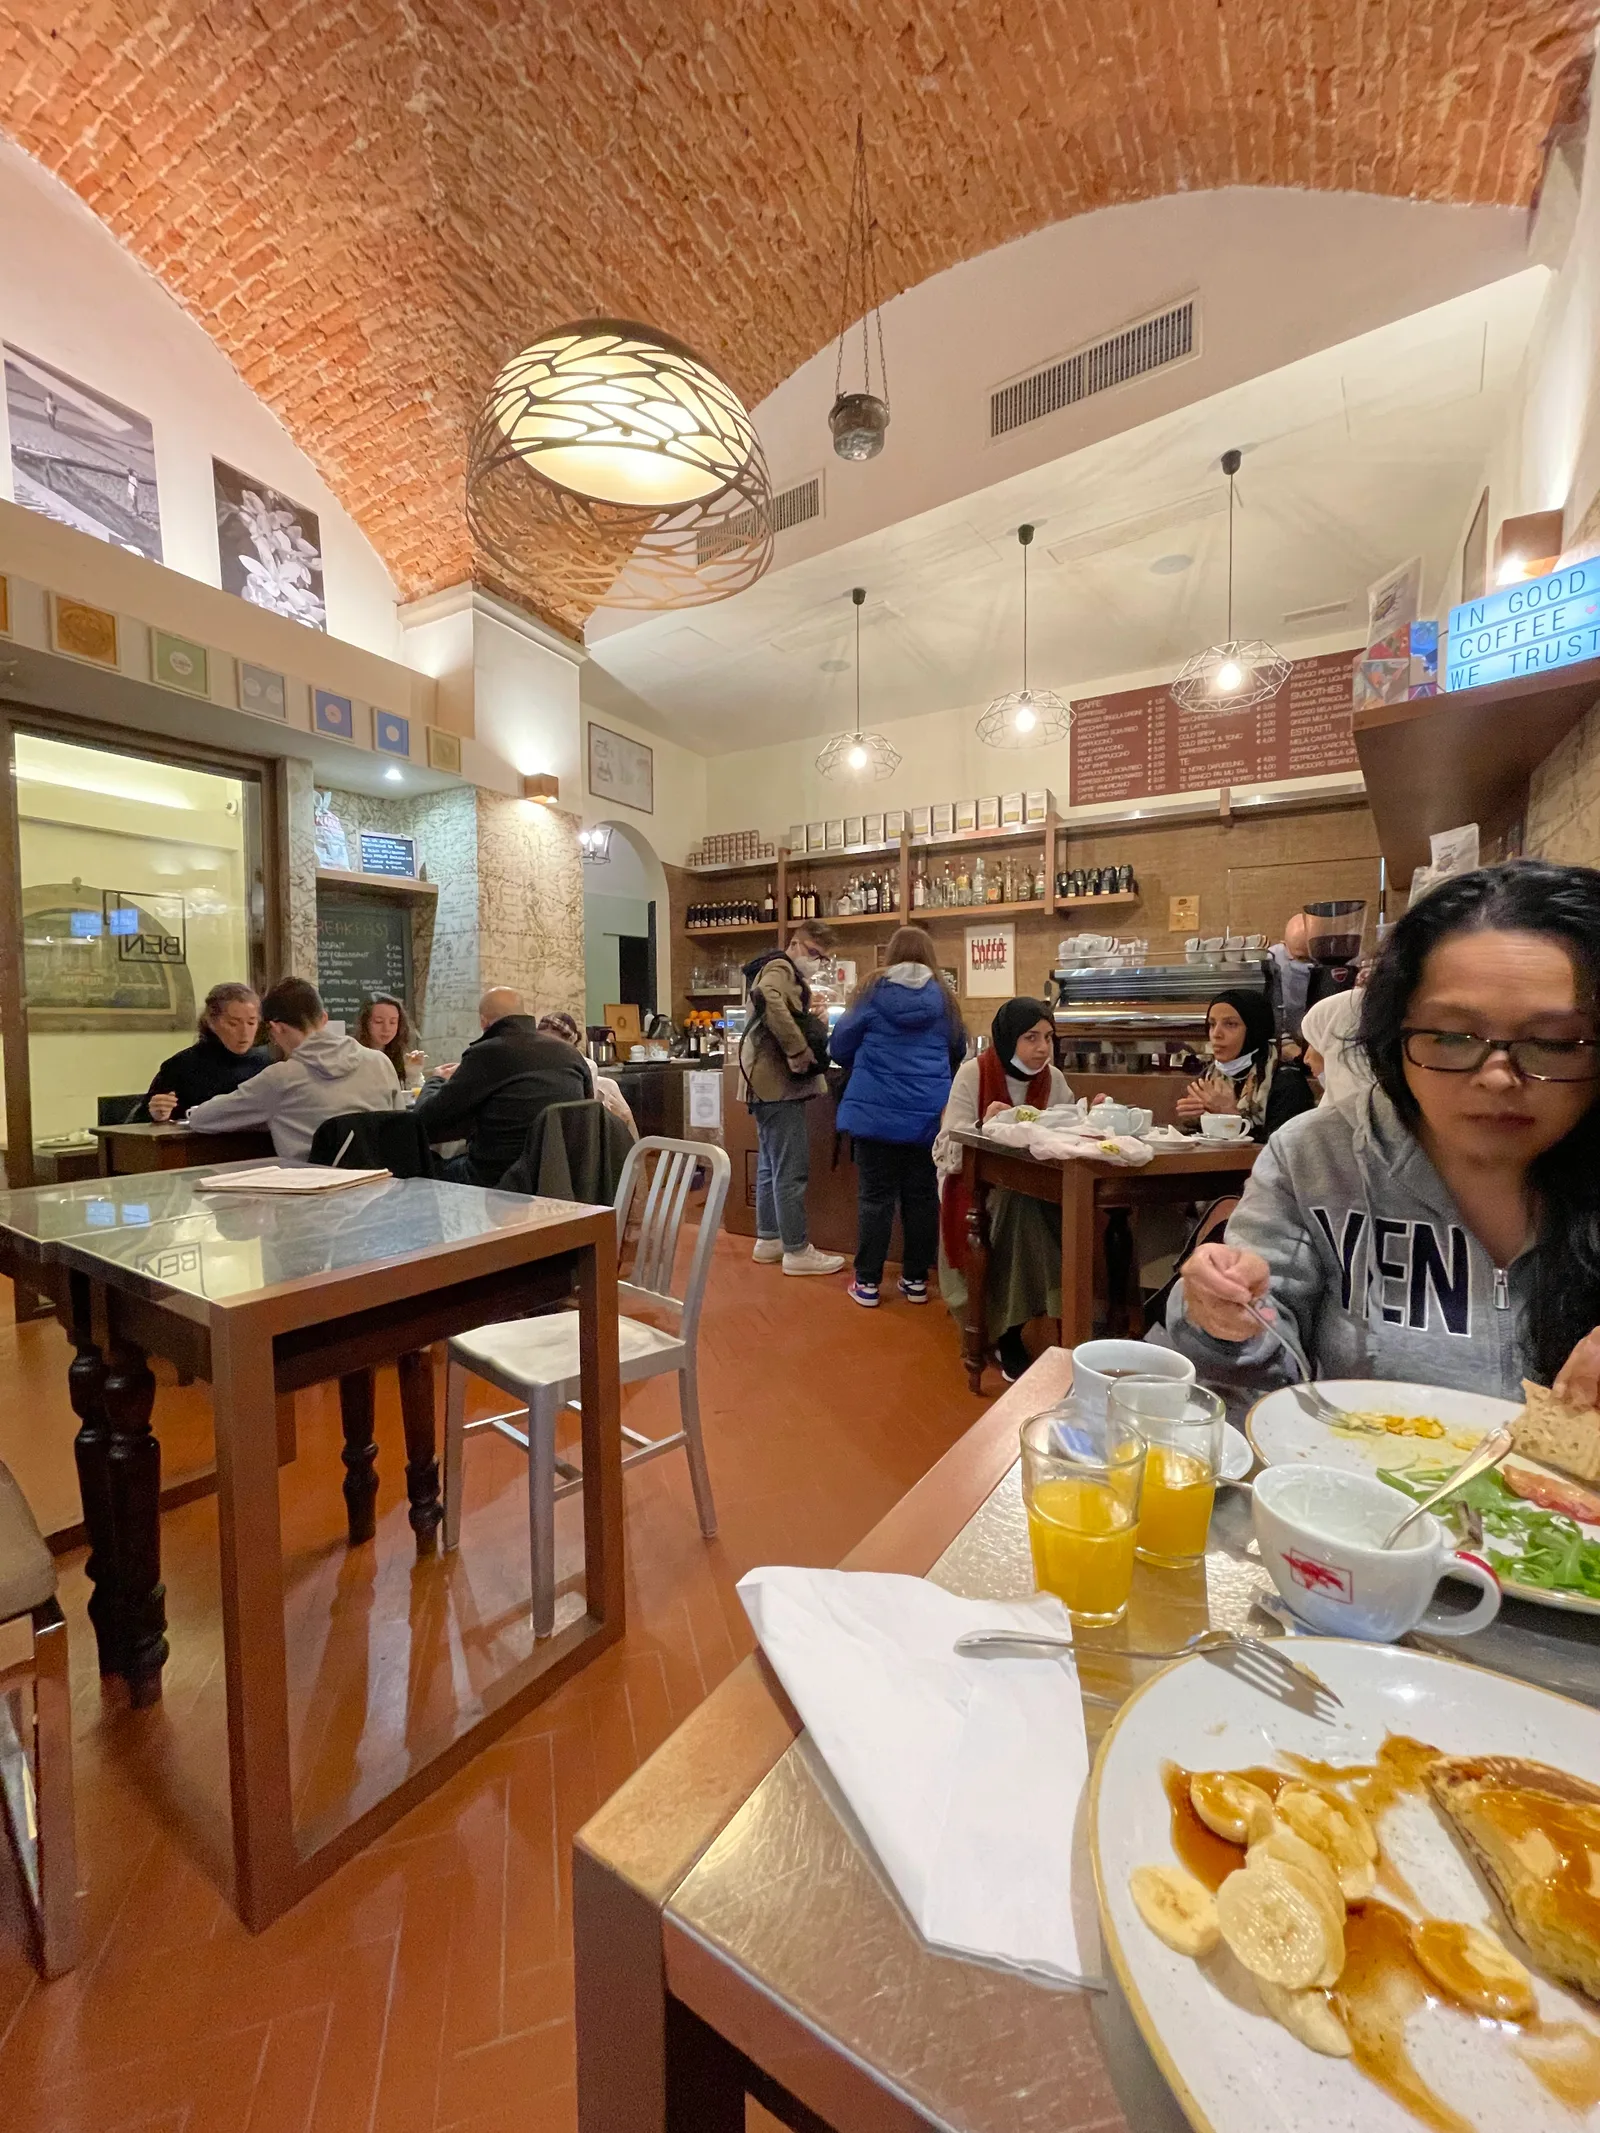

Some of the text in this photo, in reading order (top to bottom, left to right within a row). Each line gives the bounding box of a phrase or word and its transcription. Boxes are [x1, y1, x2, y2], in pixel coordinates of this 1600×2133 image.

[1456, 570, 1586, 632] IN GOOD
[1460, 607, 1567, 659] COFFEE
[1294, 660, 1316, 670] NFUSI
[1450, 629, 1600, 690] WE TRUST
[1291, 684, 1342, 699] SMOOTHIES
[1290, 724, 1331, 736] ESTRATTI
[1078, 737, 1112, 748] CAPPUCCINO
[1088, 744, 1123, 754] CAPPUCCINO
[1094, 751, 1129, 760] CAPPUCCINO
[1078, 768, 1112, 777] CAPPUCCINO
